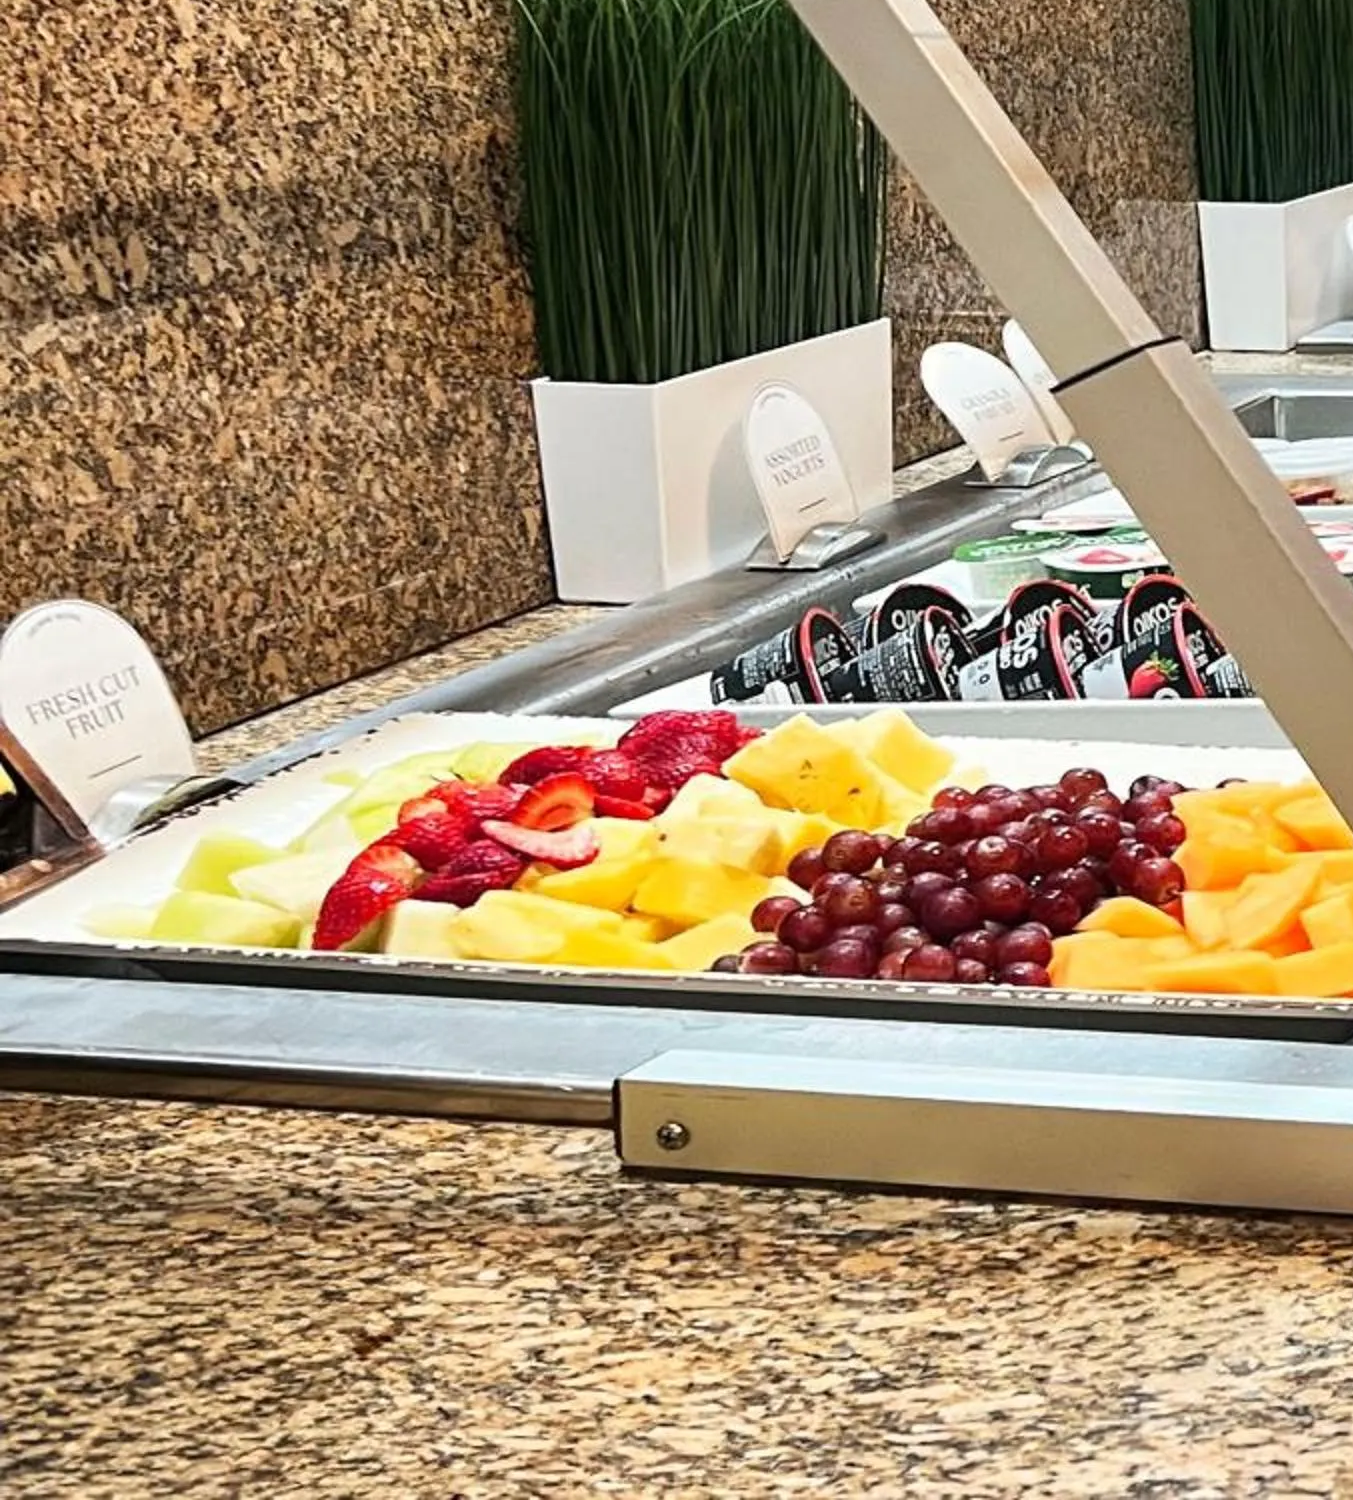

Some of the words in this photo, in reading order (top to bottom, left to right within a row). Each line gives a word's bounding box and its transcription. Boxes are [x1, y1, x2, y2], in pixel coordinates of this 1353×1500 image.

[25, 682, 98, 725] FRESH
[98, 663, 140, 698] CUT
[65, 698, 125, 741] FRUIT
